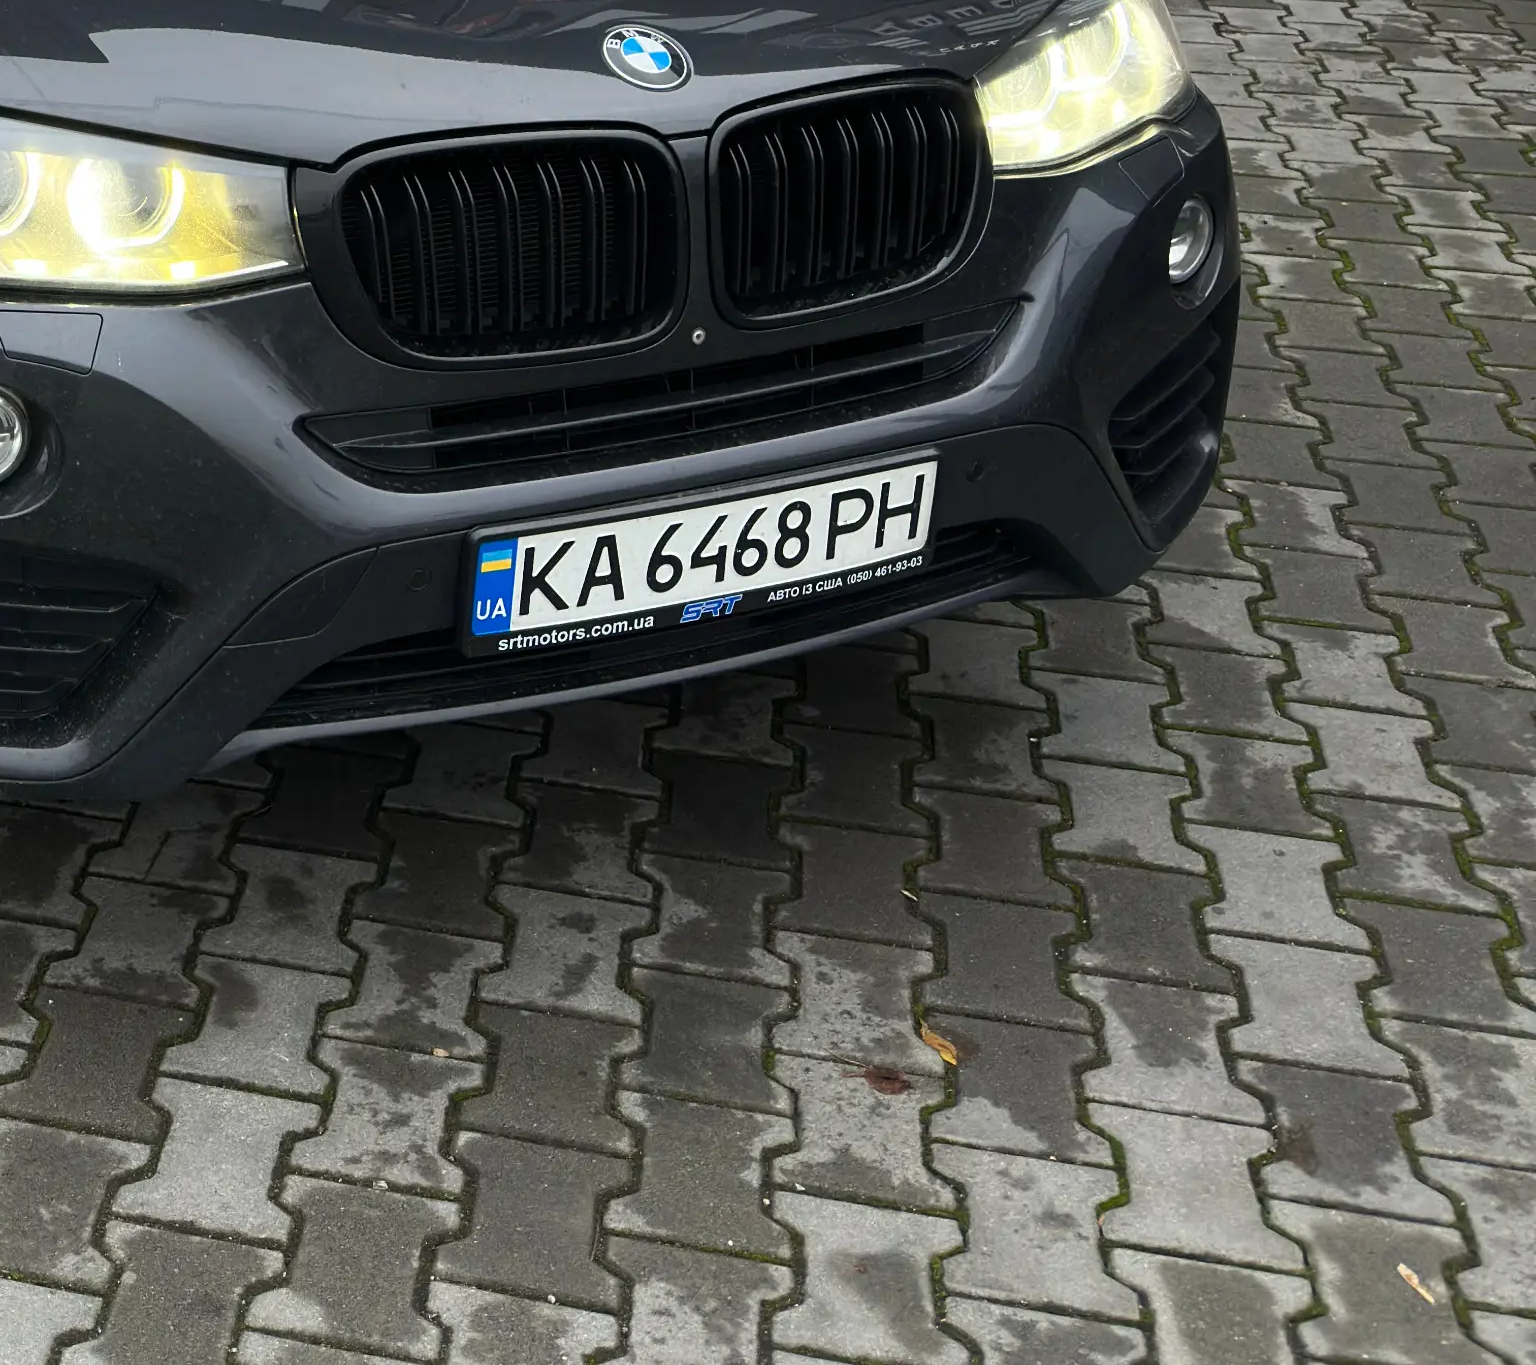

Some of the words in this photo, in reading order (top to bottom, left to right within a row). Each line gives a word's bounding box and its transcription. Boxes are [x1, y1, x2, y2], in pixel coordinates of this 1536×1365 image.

[606, 29, 665, 50] BMW
[646, 500, 813, 594] 6468
[767, 586, 800, 603] АВТО
[815, 576, 843, 592] США
[847, 569, 873, 585] (050)
[874, 555, 923, 578] 461-93-03
[476, 597, 507, 621] UA
[679, 593, 743, 624] SRT
[497, 615, 655, 652] srtmotors.com.ua
